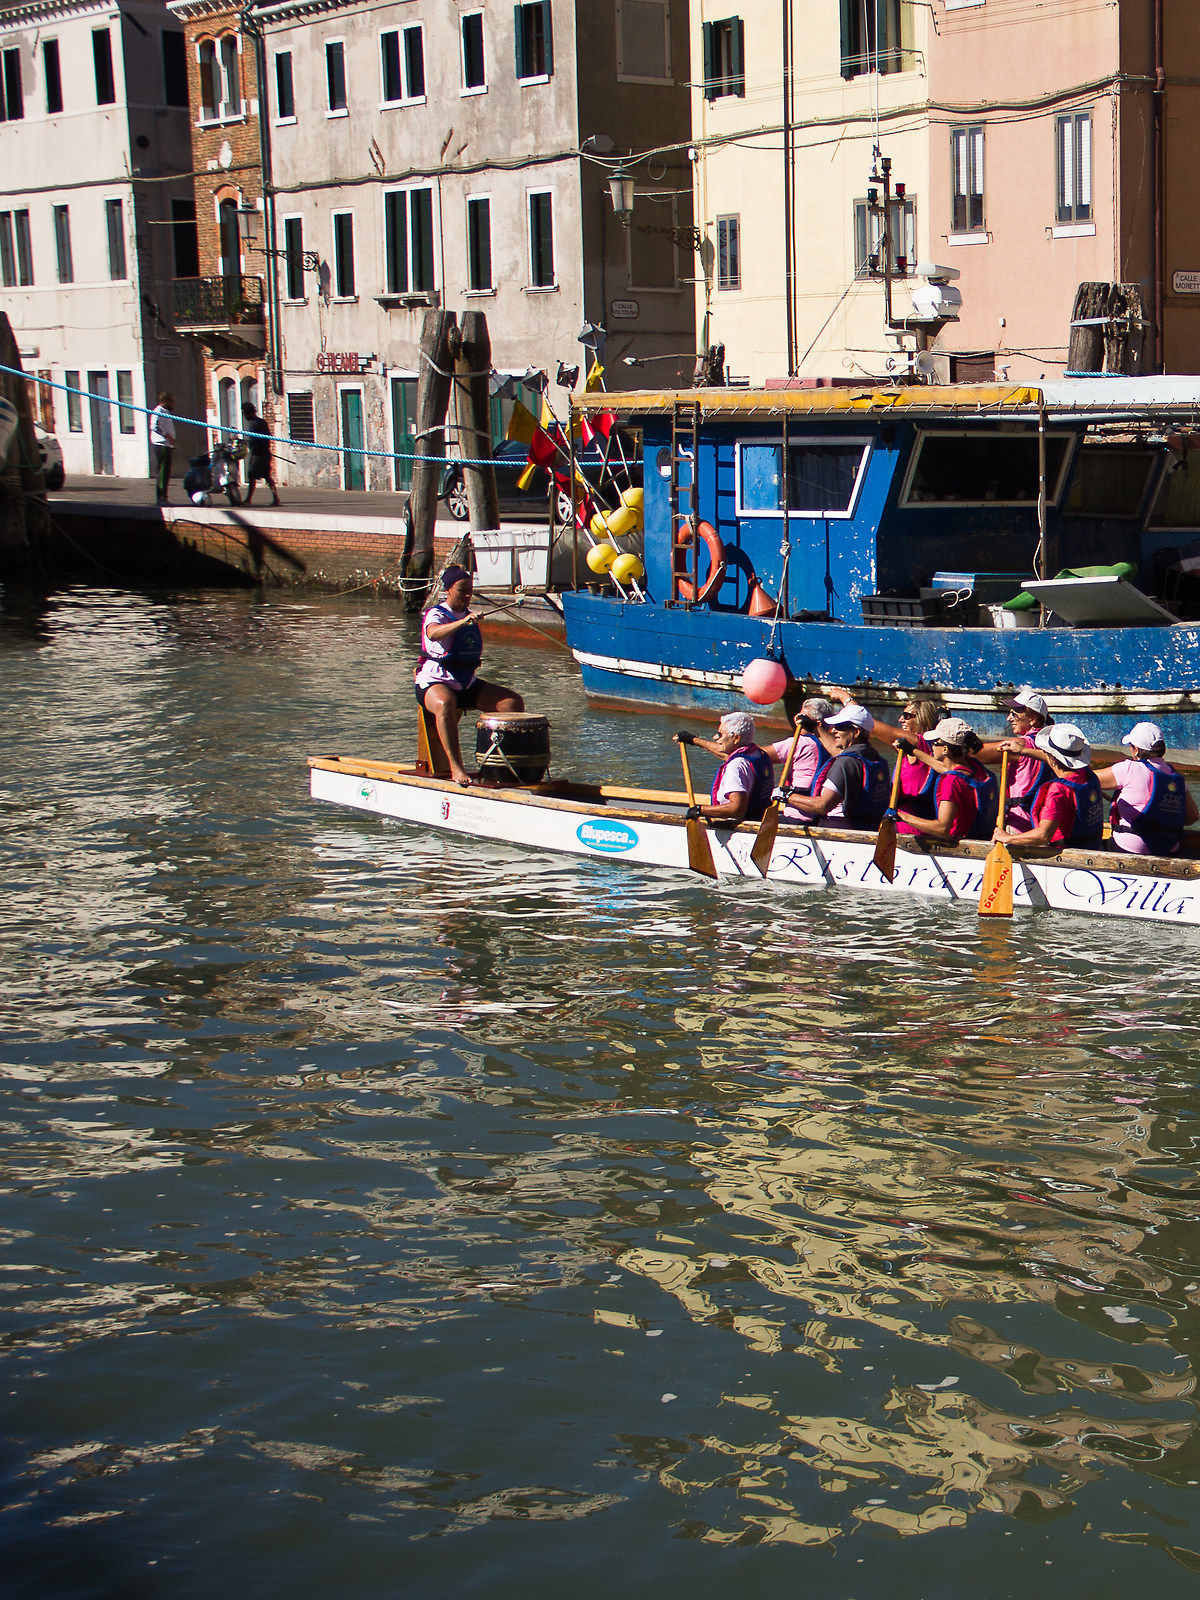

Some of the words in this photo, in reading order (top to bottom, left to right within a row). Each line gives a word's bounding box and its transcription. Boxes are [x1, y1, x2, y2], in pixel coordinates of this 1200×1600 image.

[1176, 282, 1200, 290] MORETTI
[581, 825, 629, 844] Blupesca
[766, 842, 1037, 897] Ristorane
[1063, 869, 1194, 914] Villa
[984, 866, 1010, 909] DRAGON
